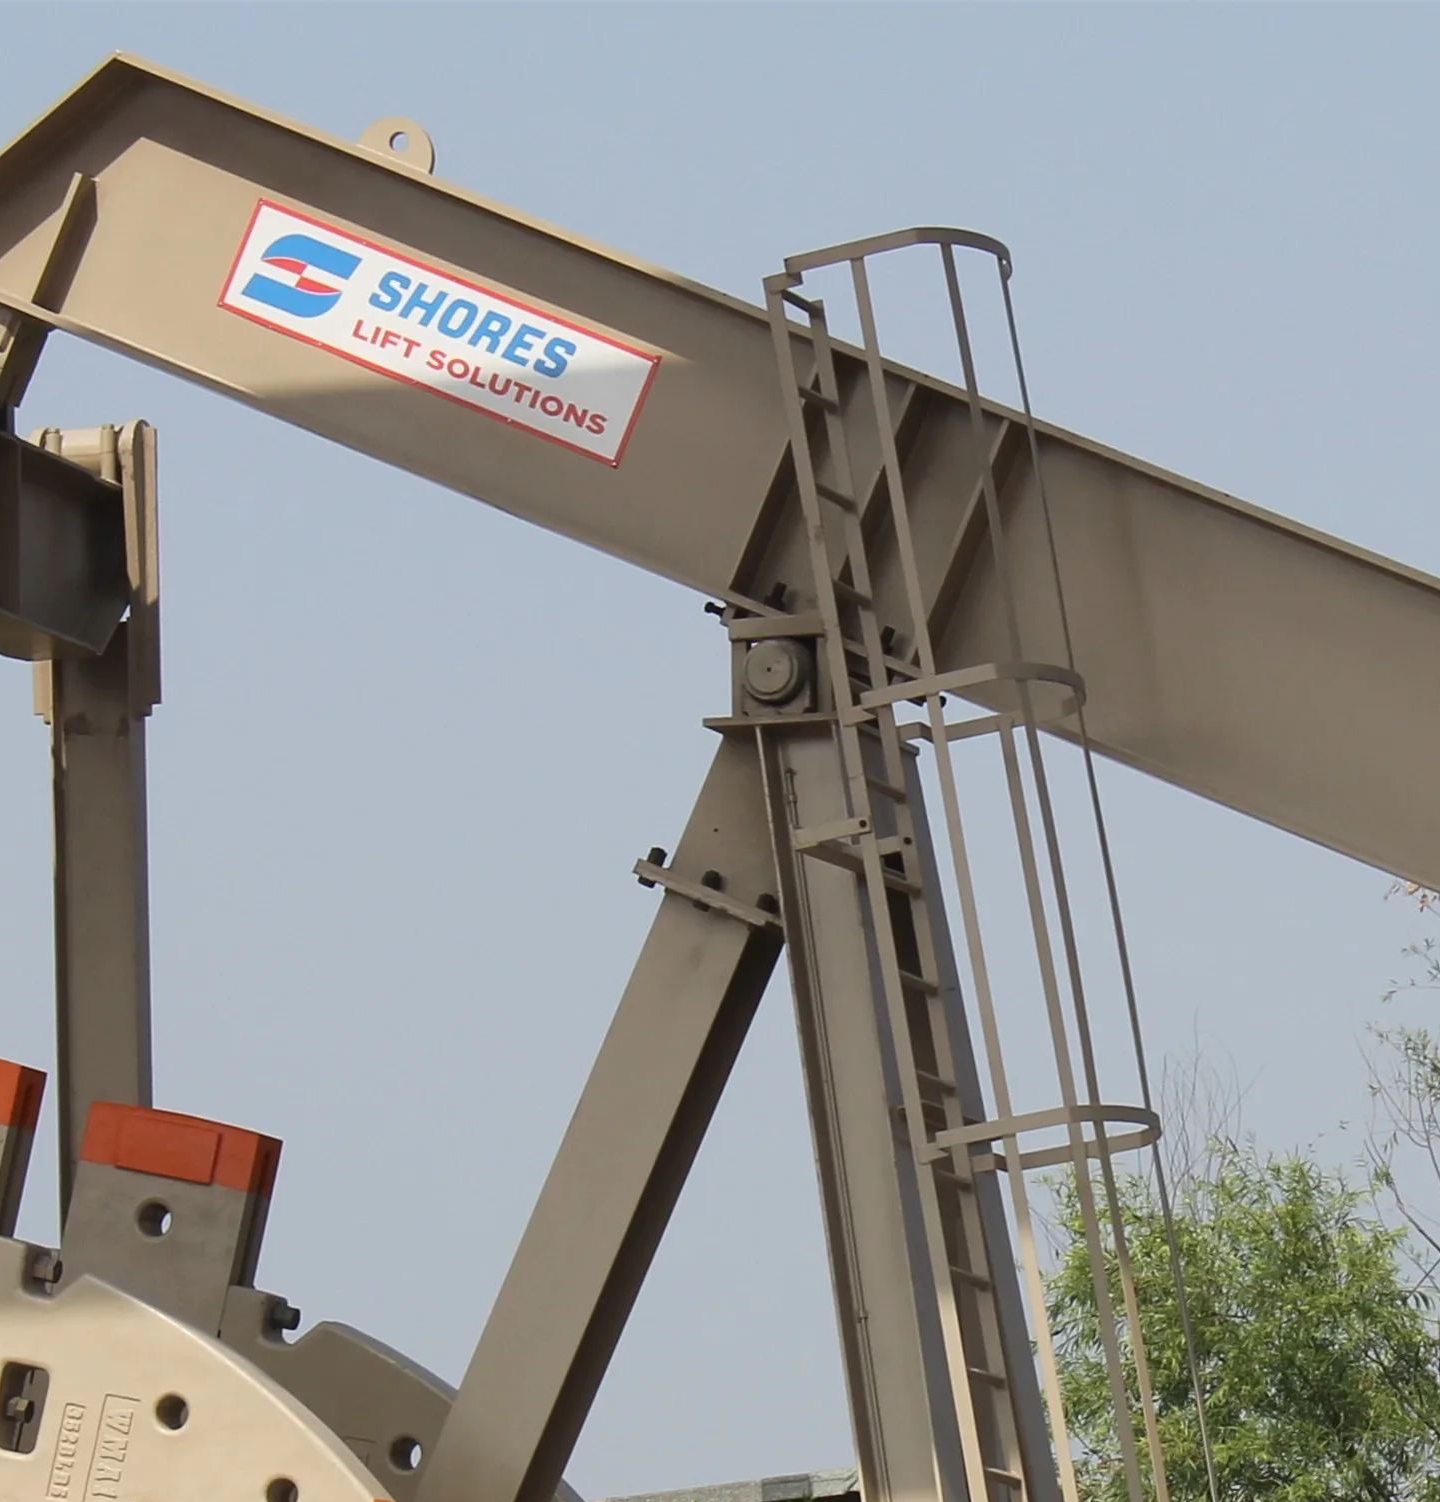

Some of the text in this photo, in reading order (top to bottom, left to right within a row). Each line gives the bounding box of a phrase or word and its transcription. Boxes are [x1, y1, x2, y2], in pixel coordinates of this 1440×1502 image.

[351, 318, 609, 436] LIFT SOLUTIONS
[368, 270, 577, 379] SHORES
